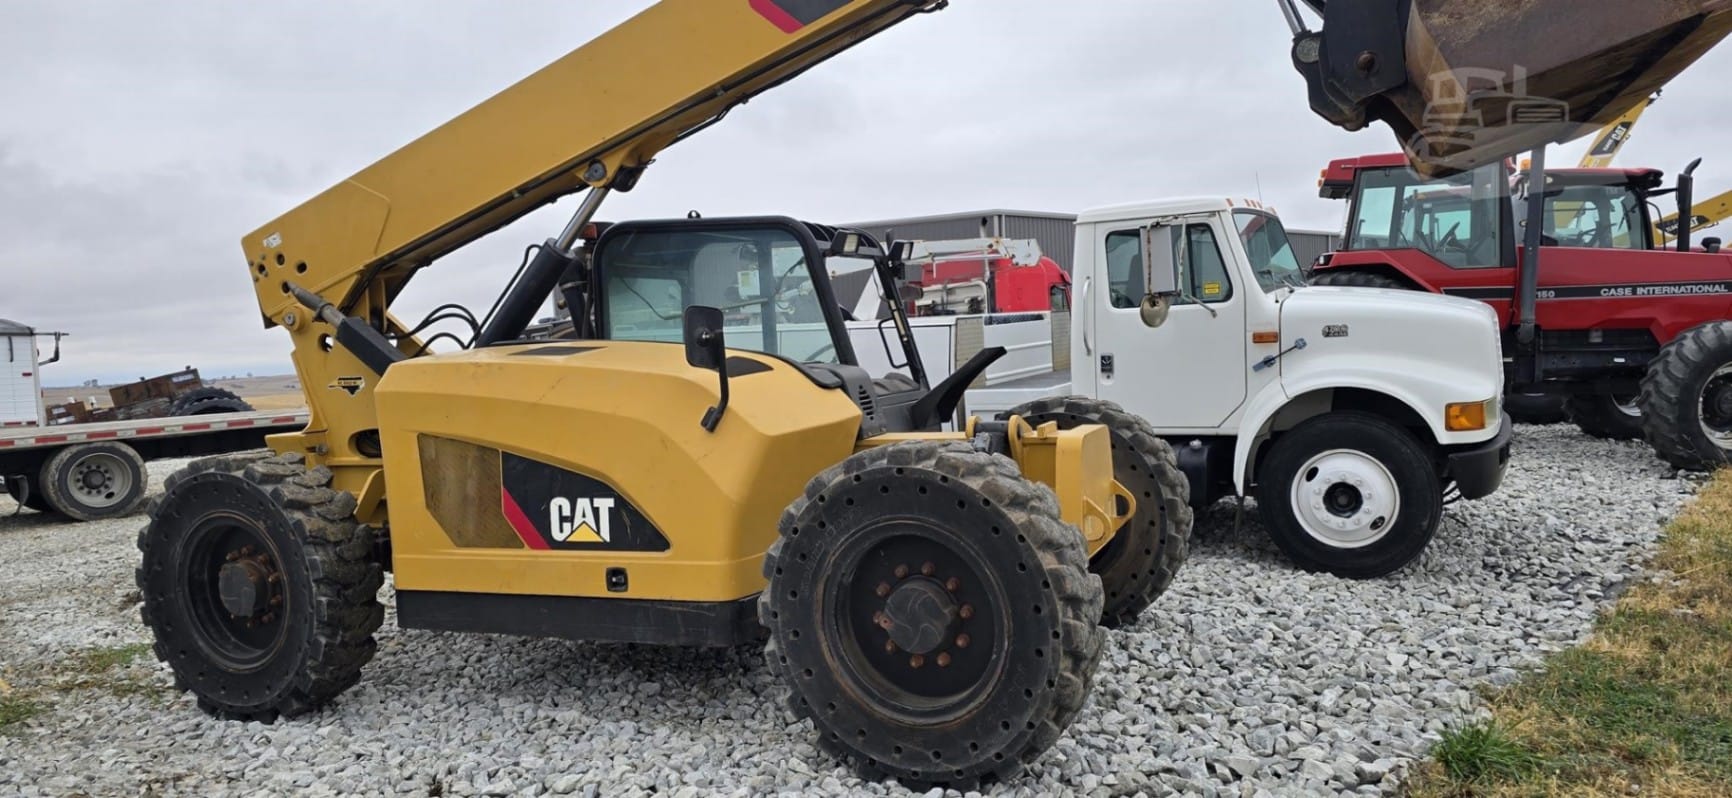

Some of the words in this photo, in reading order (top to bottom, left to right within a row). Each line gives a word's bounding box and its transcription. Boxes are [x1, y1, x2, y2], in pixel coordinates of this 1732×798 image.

[1612, 125, 1627, 140] CAT
[1536, 290, 1556, 298] 150
[1600, 287, 1632, 297] CASE
[1636, 284, 1728, 295] INTERNATIONAL
[549, 496, 615, 543] CAT
